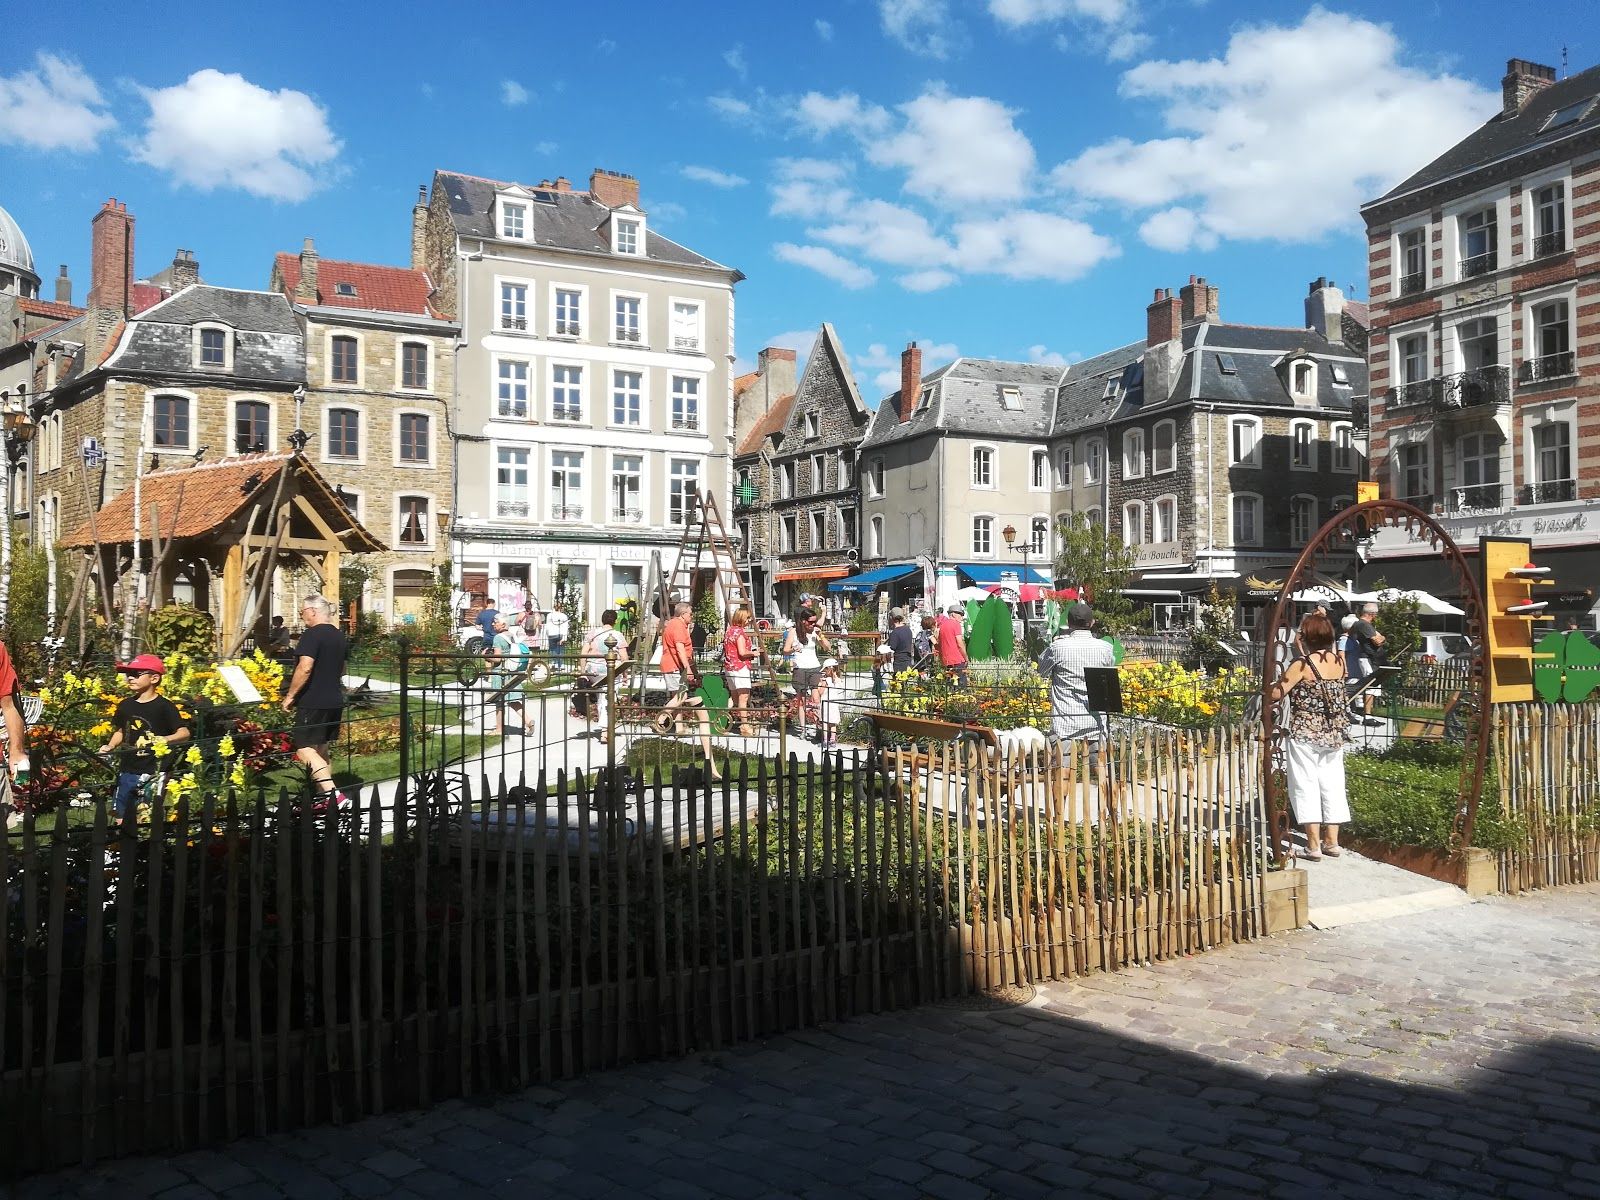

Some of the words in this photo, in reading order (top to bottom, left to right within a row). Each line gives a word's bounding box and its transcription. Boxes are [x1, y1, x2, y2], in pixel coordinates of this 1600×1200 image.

[1533, 512, 1588, 533] Brasserie
[492, 543, 561, 556] Pharmacie
[572, 544, 587, 556] de
[1149, 548, 1180, 561] Bouche
